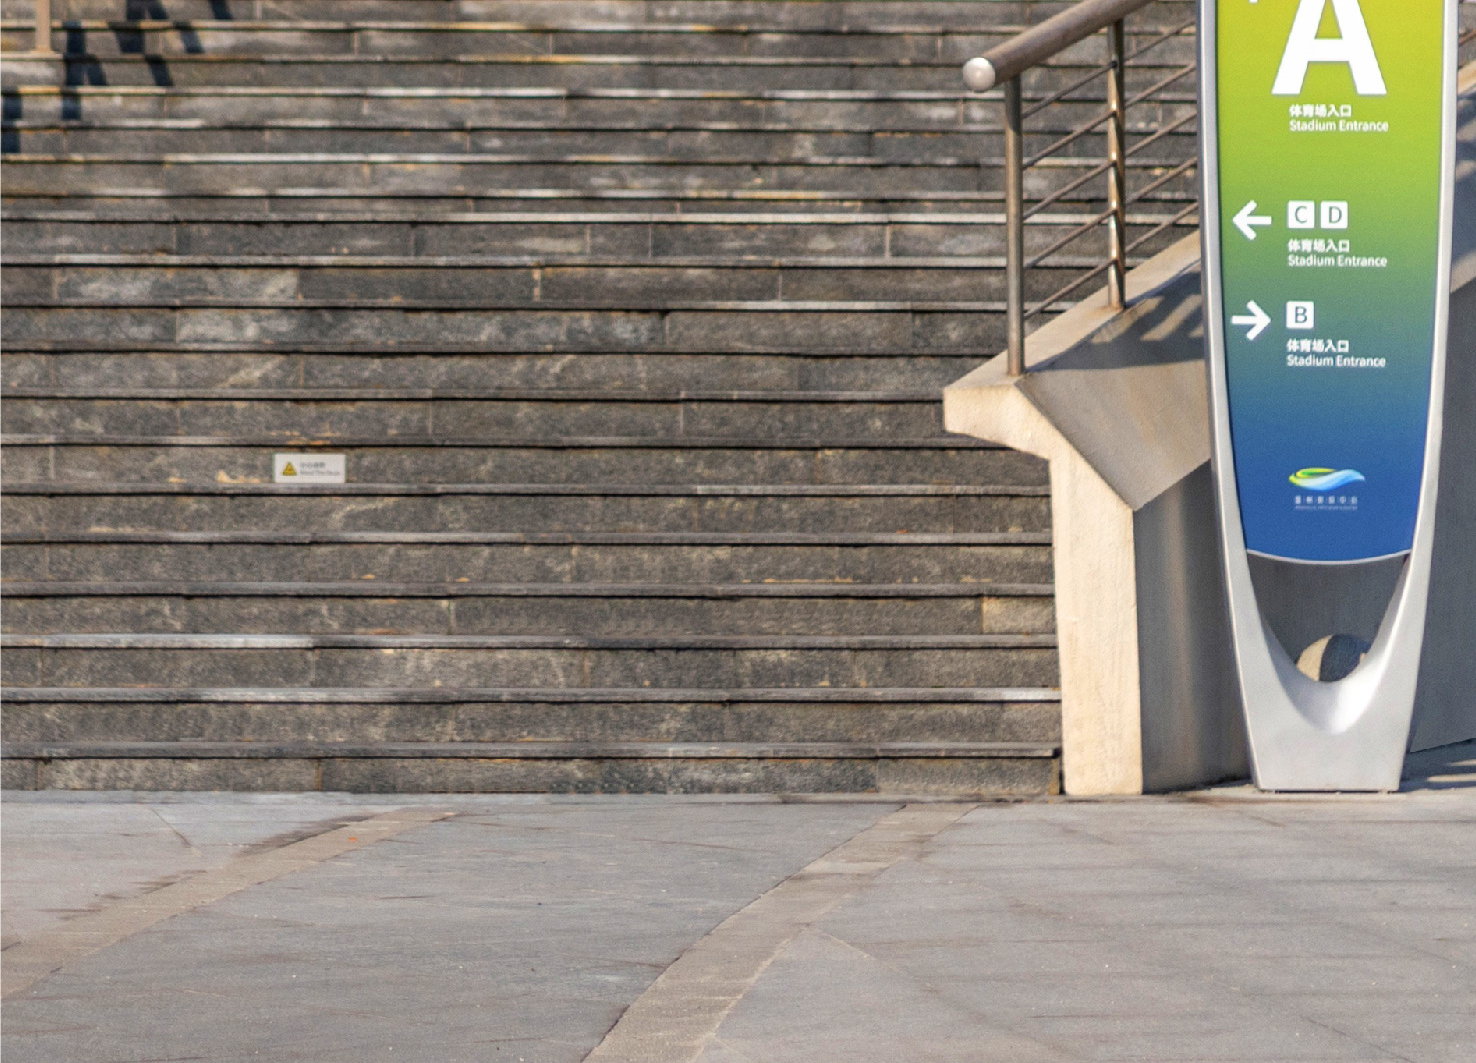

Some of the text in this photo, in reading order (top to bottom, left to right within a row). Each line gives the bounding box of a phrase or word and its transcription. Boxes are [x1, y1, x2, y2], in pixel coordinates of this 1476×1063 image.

[1289, 103, 1352, 118] 体育场入口
[1289, 119, 1389, 132] Stadium Entrance
[1294, 205, 1342, 224] C D
[1287, 238, 1350, 252] 体育场入口
[1288, 253, 1387, 267] Stadium Entrance
[1294, 305, 1308, 324] B
[1286, 338, 1349, 352] 体育场入口
[1287, 354, 1386, 368] Stadium Entrance
